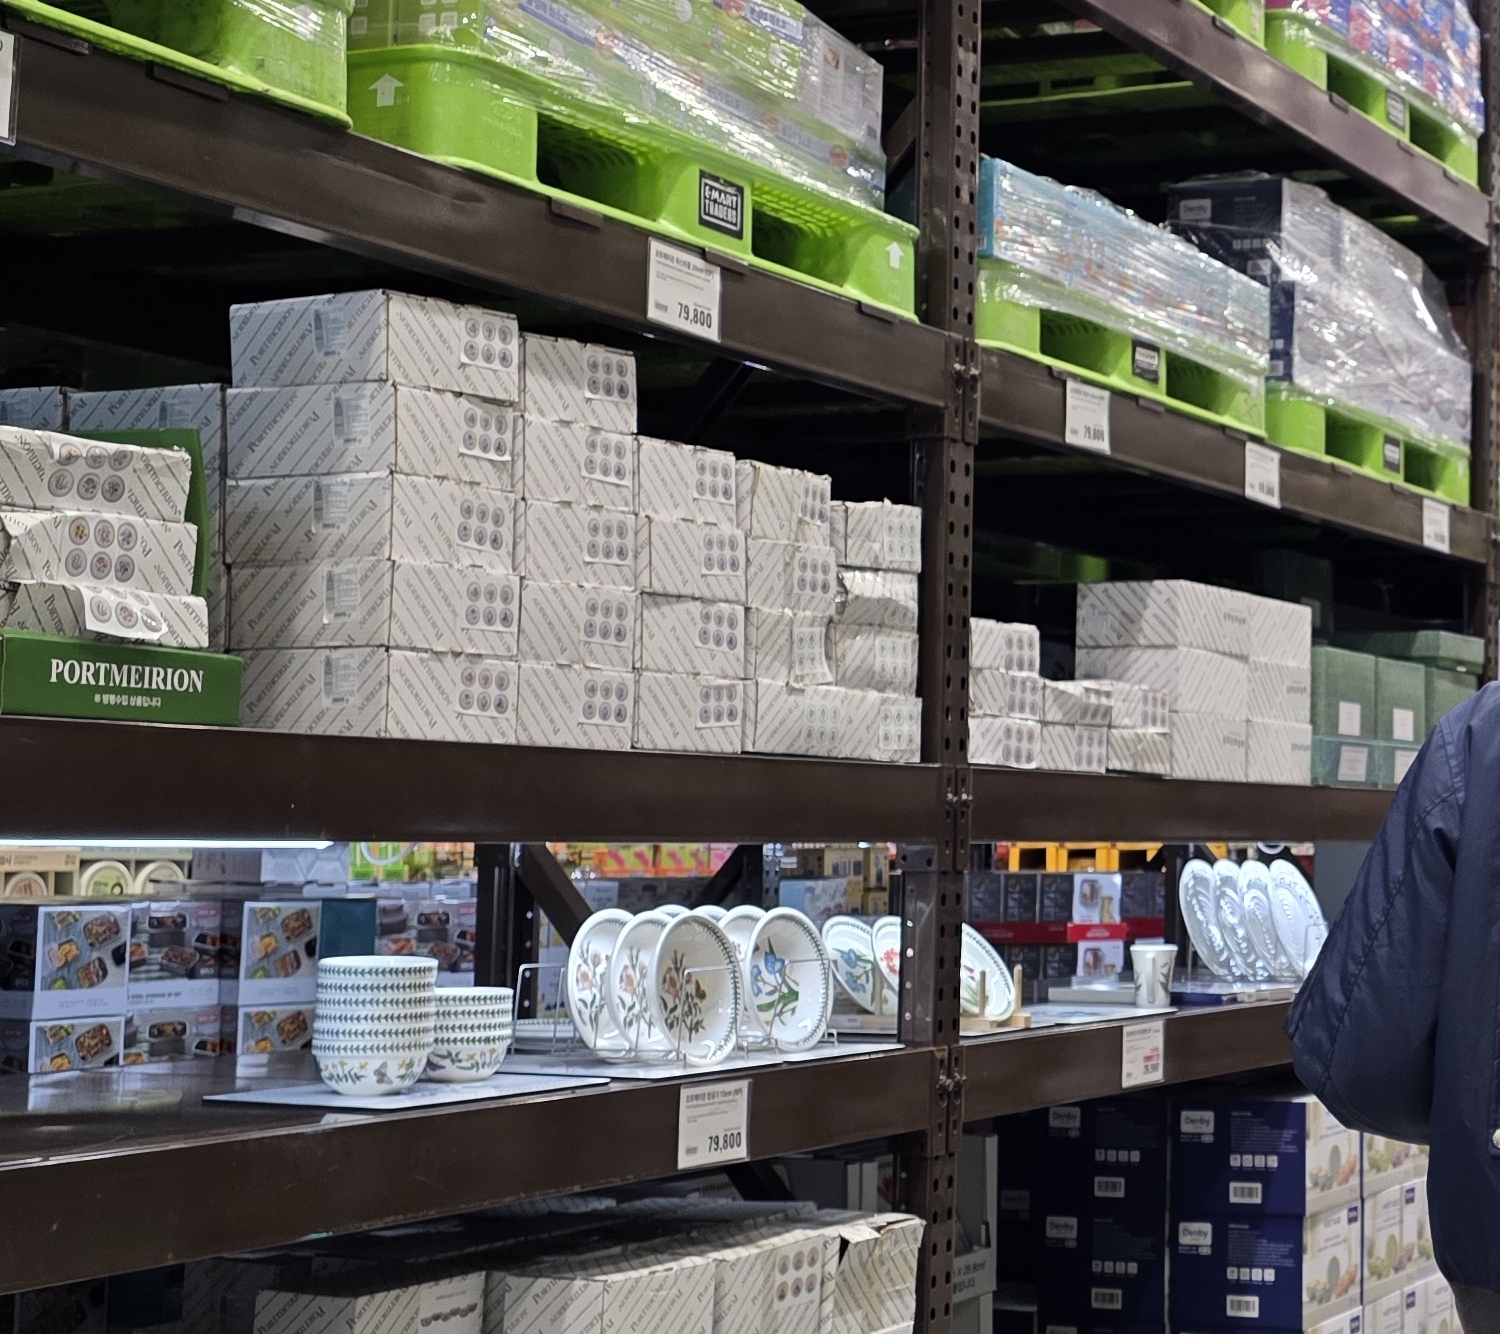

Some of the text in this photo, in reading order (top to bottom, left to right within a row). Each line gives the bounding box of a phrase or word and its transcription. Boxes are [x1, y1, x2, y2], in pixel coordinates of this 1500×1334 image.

[677, 301, 713, 329] 79,800
[50, 658, 204, 693] PORTMEIRION
[708, 1131, 742, 1154] 79,800
